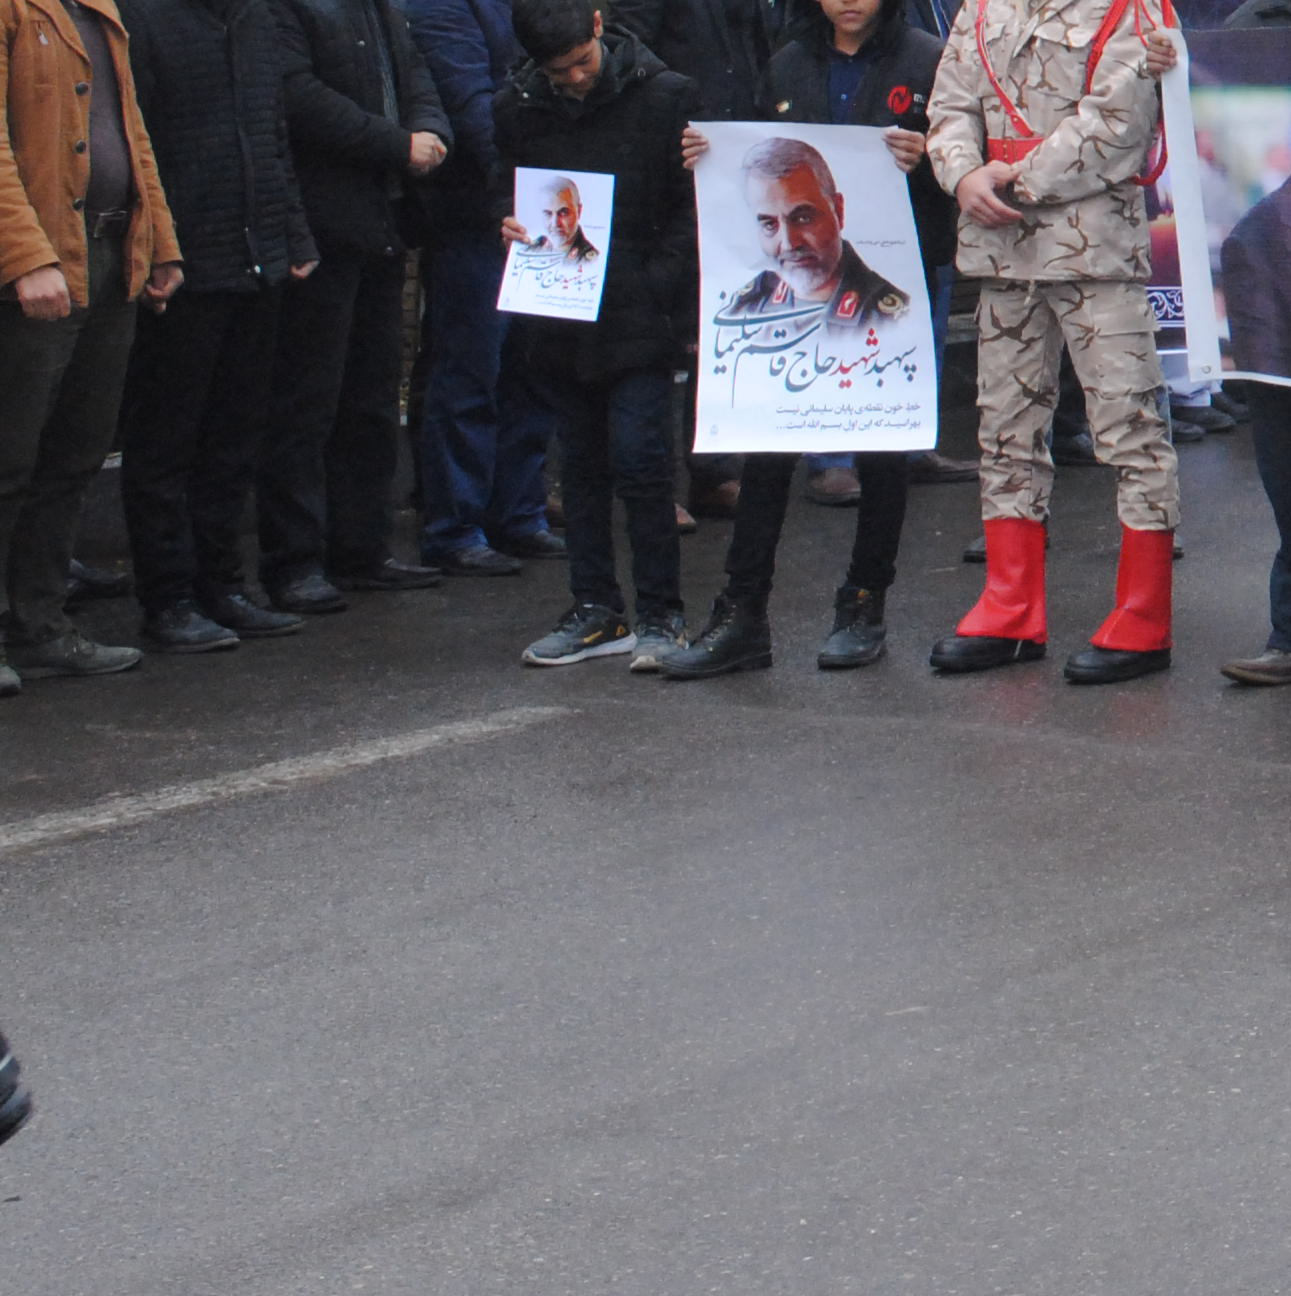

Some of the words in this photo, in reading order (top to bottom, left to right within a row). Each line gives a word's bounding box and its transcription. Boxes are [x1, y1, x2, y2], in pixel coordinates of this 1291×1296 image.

[712, 290, 826, 375] سلیمانی
[828, 327, 882, 390] شهید
[731, 321, 823, 409] قاسم
[784, 341, 837, 393] حاج
[863, 344, 918, 389] سپهبد
